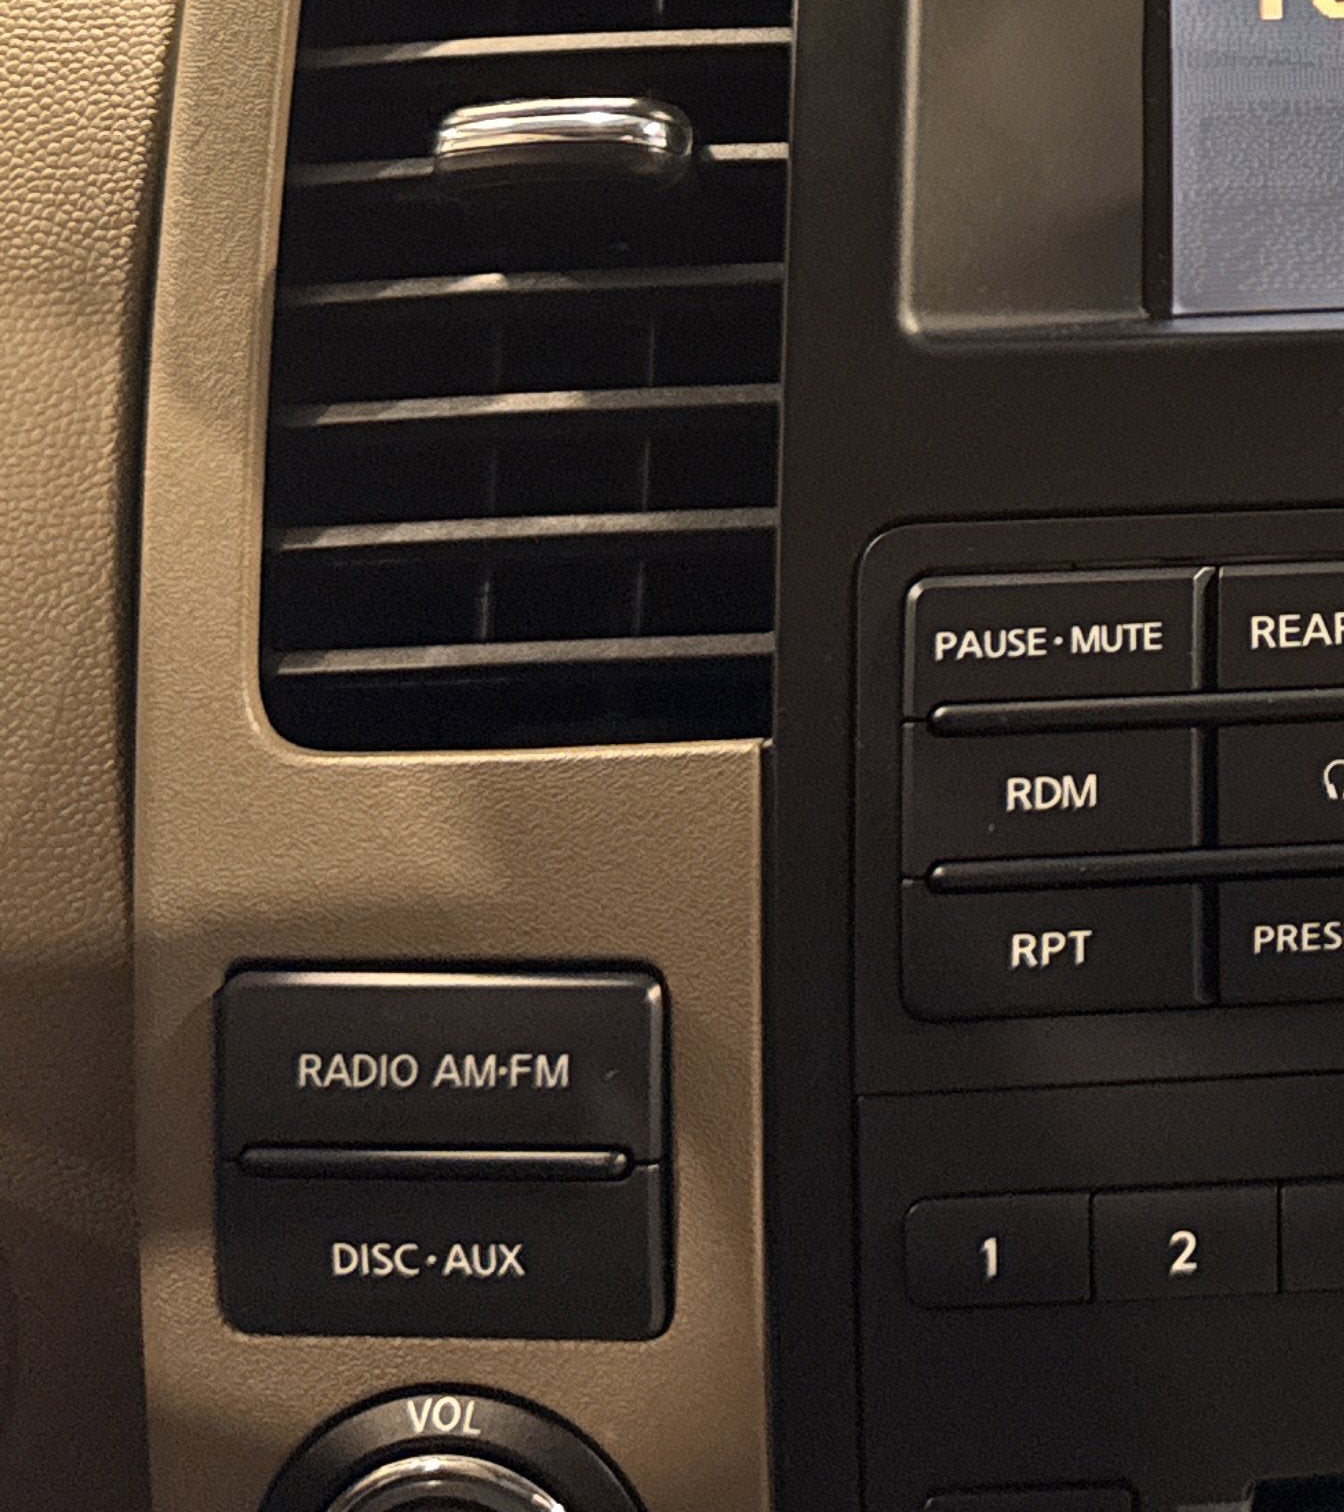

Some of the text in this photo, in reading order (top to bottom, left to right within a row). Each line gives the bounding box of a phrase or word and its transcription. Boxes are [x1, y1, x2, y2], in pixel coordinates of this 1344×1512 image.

[1006, 775, 1098, 811] RDM
[1011, 929, 1092, 968] RPT
[299, 1053, 418, 1088] RADIO
[981, 1236, 998, 1279] 1
[1168, 1230, 1198, 1277] 2
[406, 1396, 481, 1435] VOL
